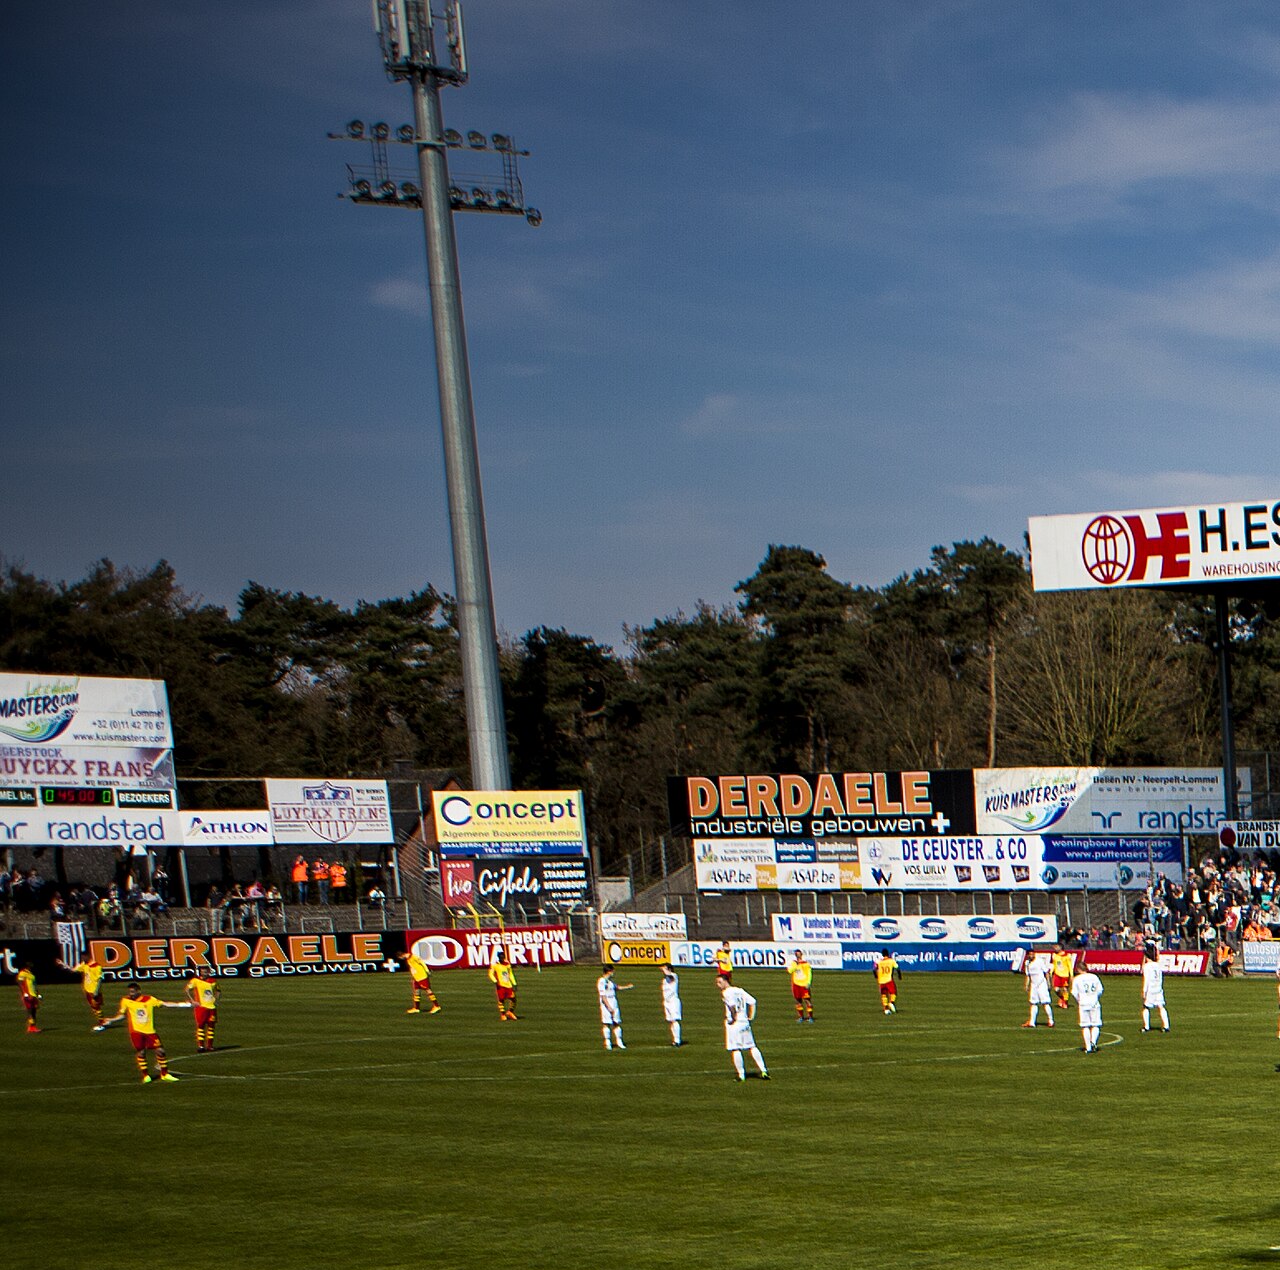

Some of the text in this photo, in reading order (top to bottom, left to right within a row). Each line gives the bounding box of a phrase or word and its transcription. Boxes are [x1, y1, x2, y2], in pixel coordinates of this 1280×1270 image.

[130, 708, 165, 718] Lommel
[73, 732, 168, 743] www.kuismasters.com
[84, 760, 155, 777] FRANS
[1122, 775, 1136, 784] NV
[1143, 775, 1219, 785] Neerpelt-Lommel
[119, 792, 170, 804] BEZOEKERS
[687, 771, 933, 818] DERDAELE
[440, 796, 577, 826] Concept
[985, 794, 1008, 813] KUIS
[272, 806, 387, 821] LUYCKX FRANS
[47, 815, 166, 841] randstad
[190, 816, 268, 834] ATHLON
[690, 817, 926, 836] industriële gebouwen
[442, 830, 581, 838] Algemene Bouwonderneming
[1237, 832, 1261, 848] VAN
[902, 837, 1027, 861] DE CEUSTER & CO
[1052, 838, 1117, 849] woningbouw
[709, 868, 752, 884] ASAP.be
[791, 868, 835, 884] ASAP.be
[904, 864, 947, 875] VOS WILLY
[447, 869, 473, 898] Ivo
[465, 928, 568, 947] WEGENBOUW
[90, 934, 385, 968] DERDAELE
[608, 941, 667, 963] Concept
[248, 963, 377, 979] gebouwen
[1159, 954, 1204, 973] ELTRI
